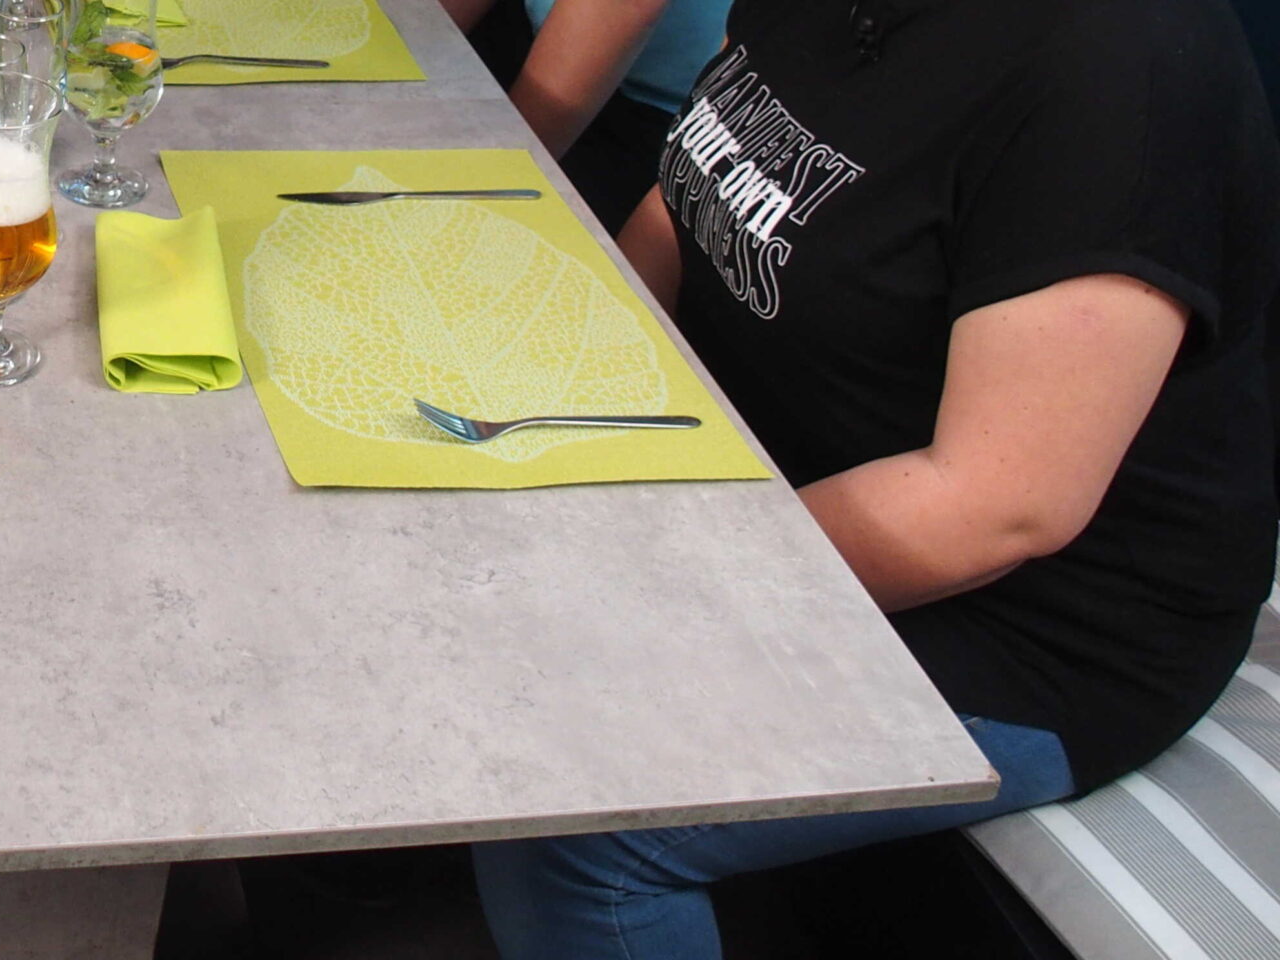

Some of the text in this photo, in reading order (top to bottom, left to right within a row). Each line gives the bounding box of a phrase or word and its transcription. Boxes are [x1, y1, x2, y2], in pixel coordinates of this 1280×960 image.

[659, 113, 792, 320] PPINESS
[667, 96, 792, 243] your own
